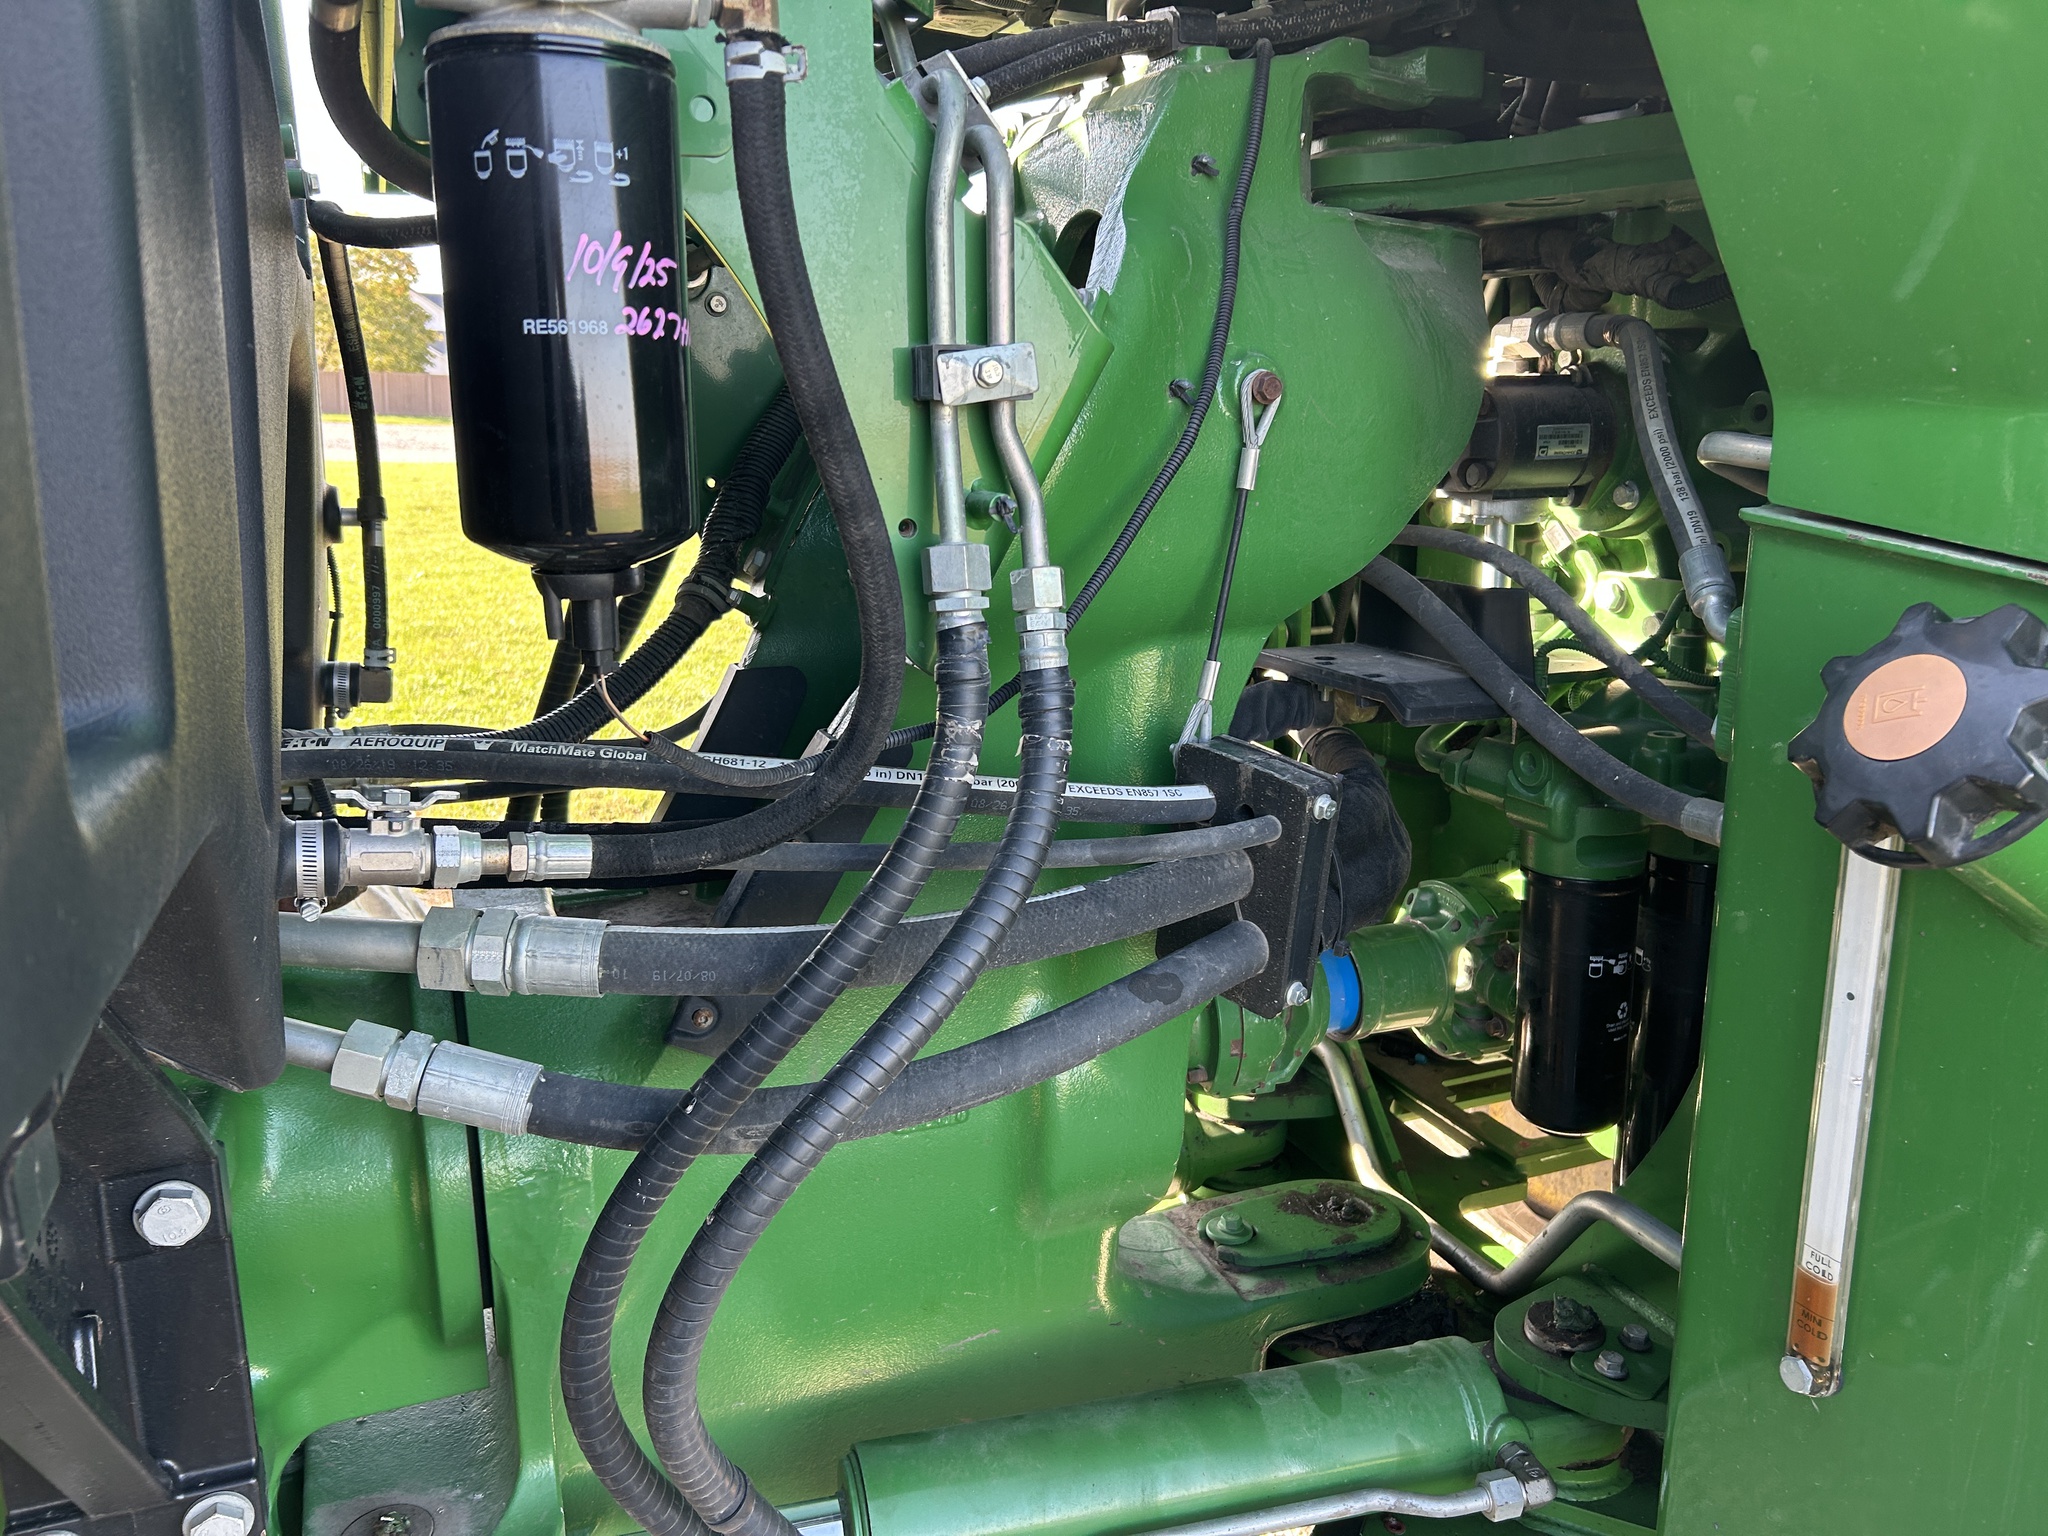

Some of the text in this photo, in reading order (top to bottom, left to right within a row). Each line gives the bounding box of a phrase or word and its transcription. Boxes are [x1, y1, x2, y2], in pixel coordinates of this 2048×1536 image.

[565, 229, 678, 294] 10/9/25
[522, 318, 609, 336] RE561968
[1638, 354, 1651, 378] EN857
[1642, 378, 1659, 420] EXCEEDS
[1653, 428, 1668, 444] psi)
[1659, 446, 1677, 470] (2000
[1672, 472, 1683, 486] bar
[1675, 486, 1690, 502] 138
[1687, 510, 1704, 534] DN19
[372, 585, 382, 630] 0000997
[349, 737, 445, 748] AEROQUIP
[509, 741, 596, 757] MatchMate
[599, 746, 648, 762] Global
[896, 770, 925, 781] DN1
[1068, 784, 1123, 796] EXCEEDS
[1126, 788, 1159, 797] EN857
[1162, 789, 1183, 797] 1SC
[652, 969, 716, 982] 08/07/19
[1805, 1261, 1834, 1281] COLD
[1810, 1250, 1831, 1269] FULL
[1796, 1318, 1828, 1341] COLD
[1801, 1309, 1823, 1327] MIN
